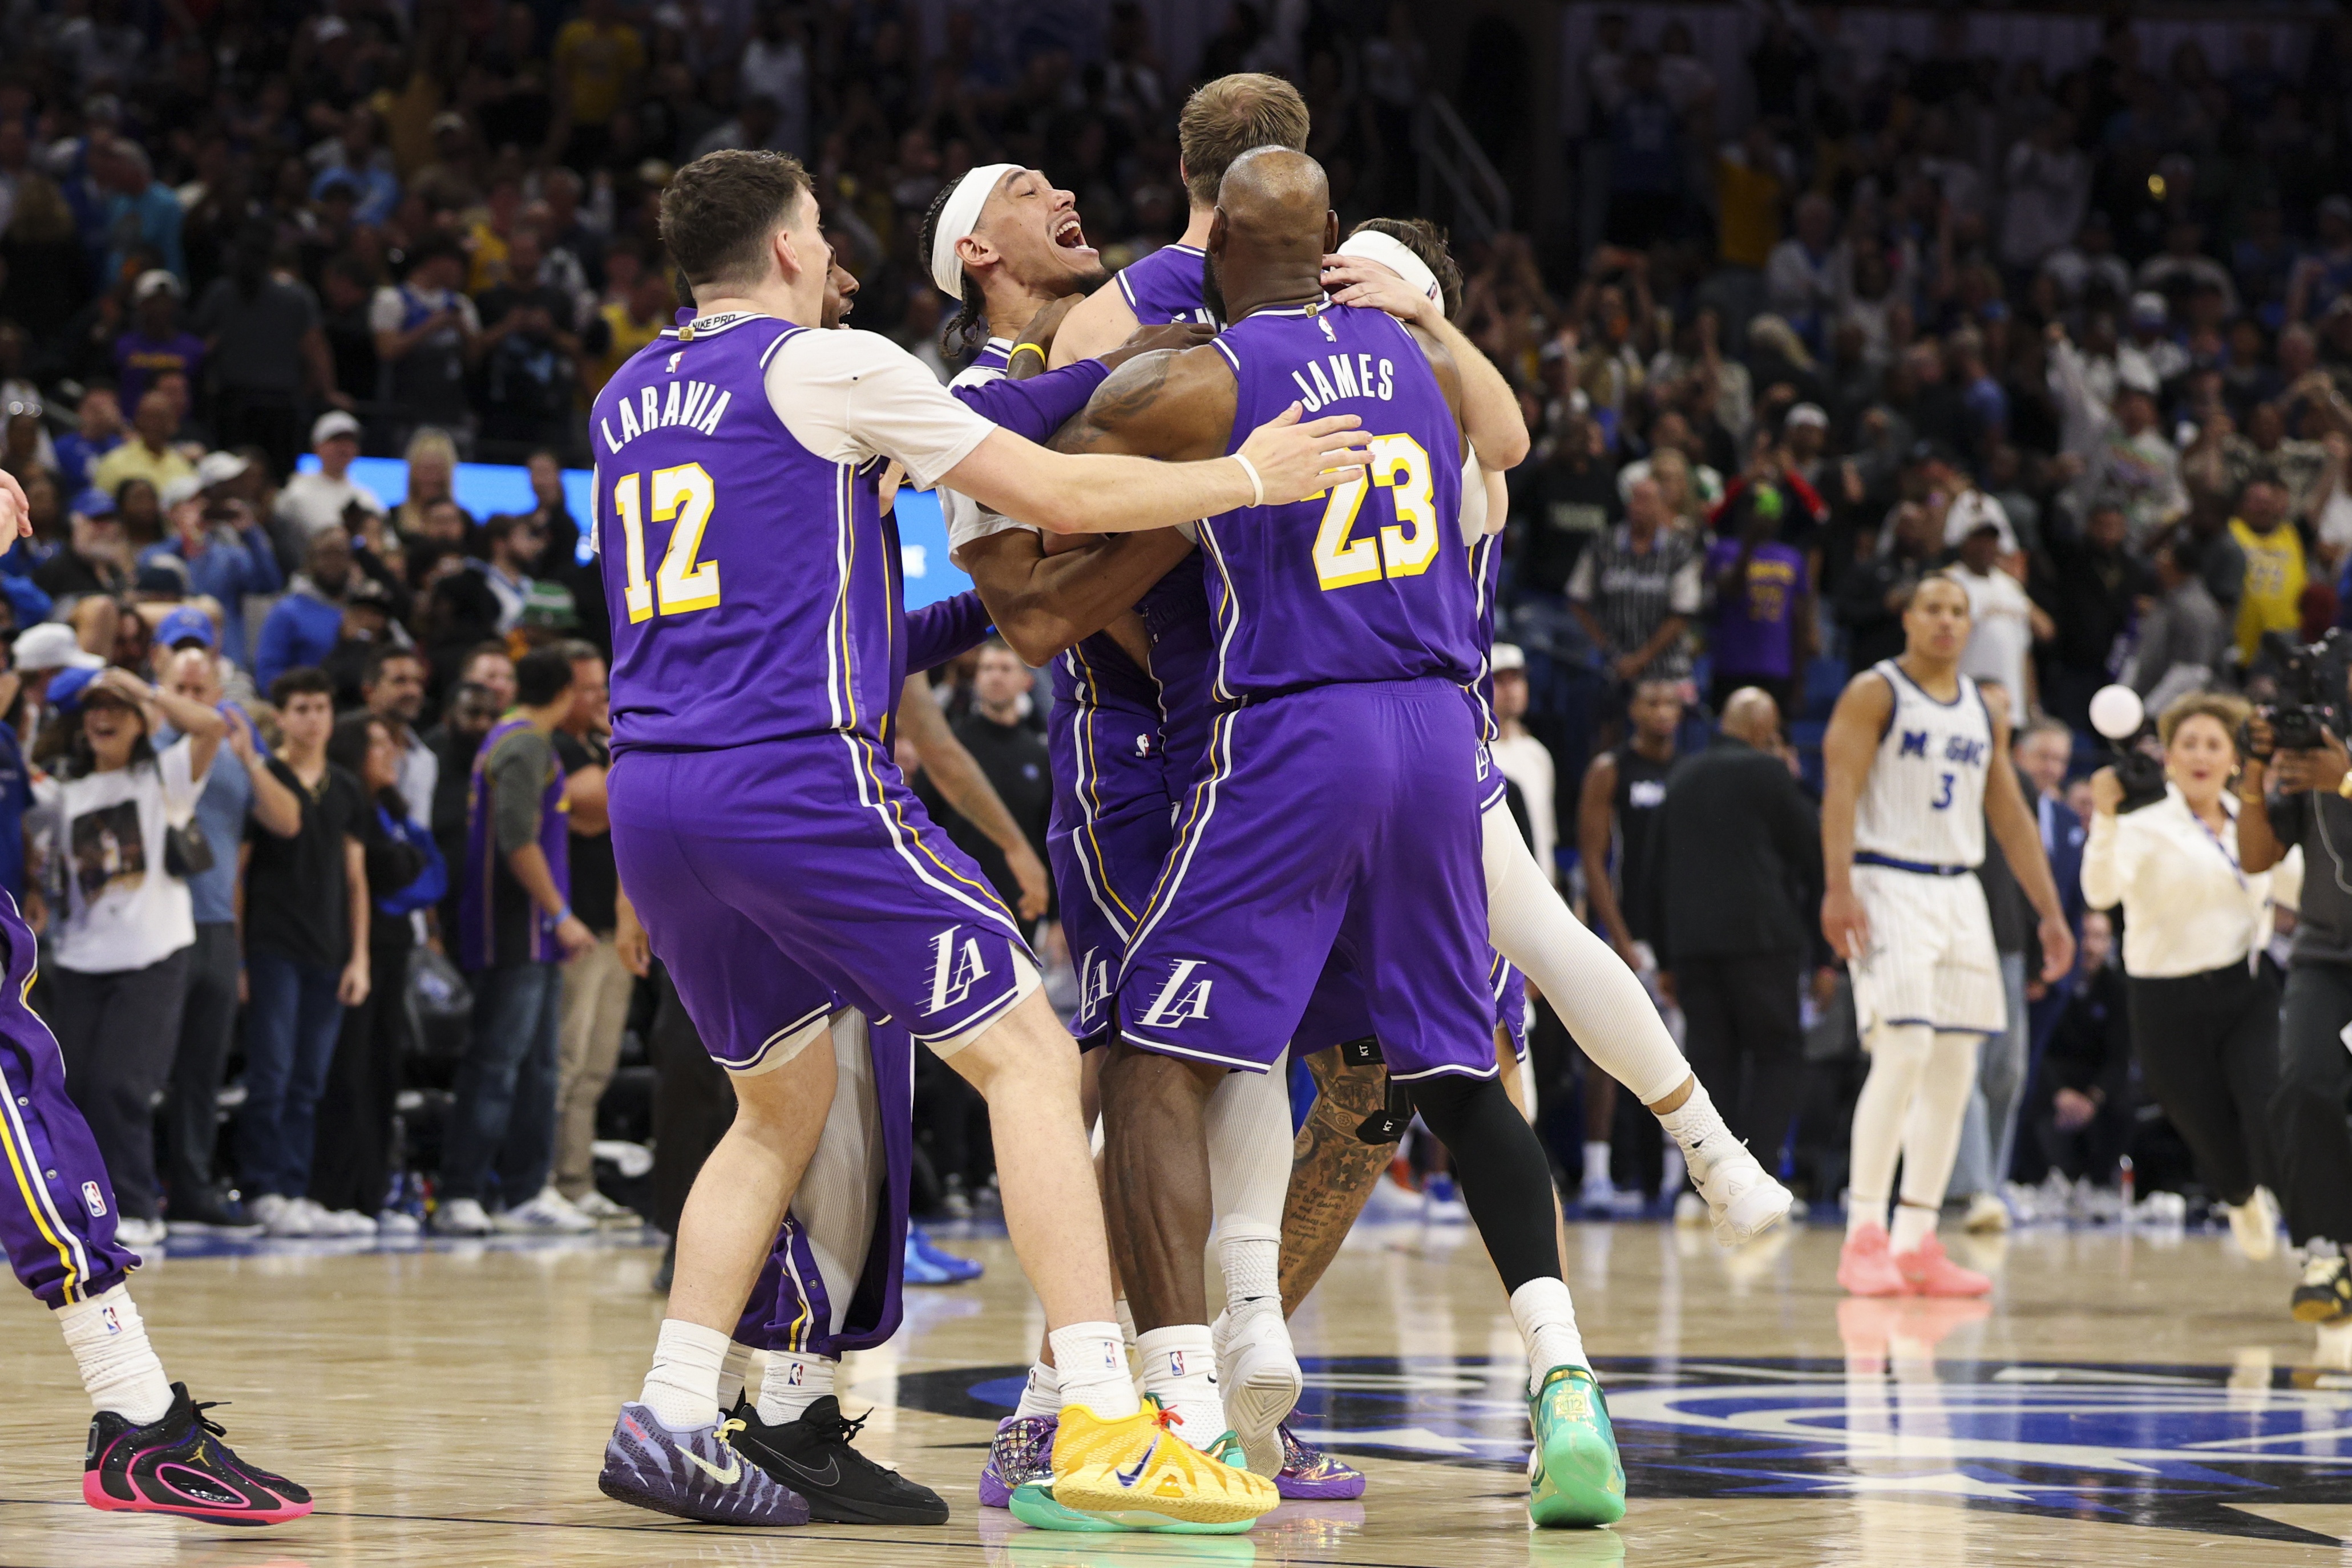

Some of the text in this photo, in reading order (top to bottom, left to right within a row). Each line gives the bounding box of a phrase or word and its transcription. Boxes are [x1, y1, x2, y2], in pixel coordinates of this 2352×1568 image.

[693, 314, 735, 329] NIKE PRO
[1291, 353, 1393, 413] JAMES
[600, 380, 732, 454] LARAVIA
[614, 462, 720, 624] 12
[1300, 432, 1439, 592] 23
[1931, 773, 1955, 810] 3
[915, 924, 991, 1017] LA
[1080, 945, 1113, 1028] LA
[1133, 959, 1213, 1028] LA
[1359, 1045, 1369, 1057] KT
[1383, 1120, 1393, 1131] KT
[624, 1416, 648, 1442] TWELVE
